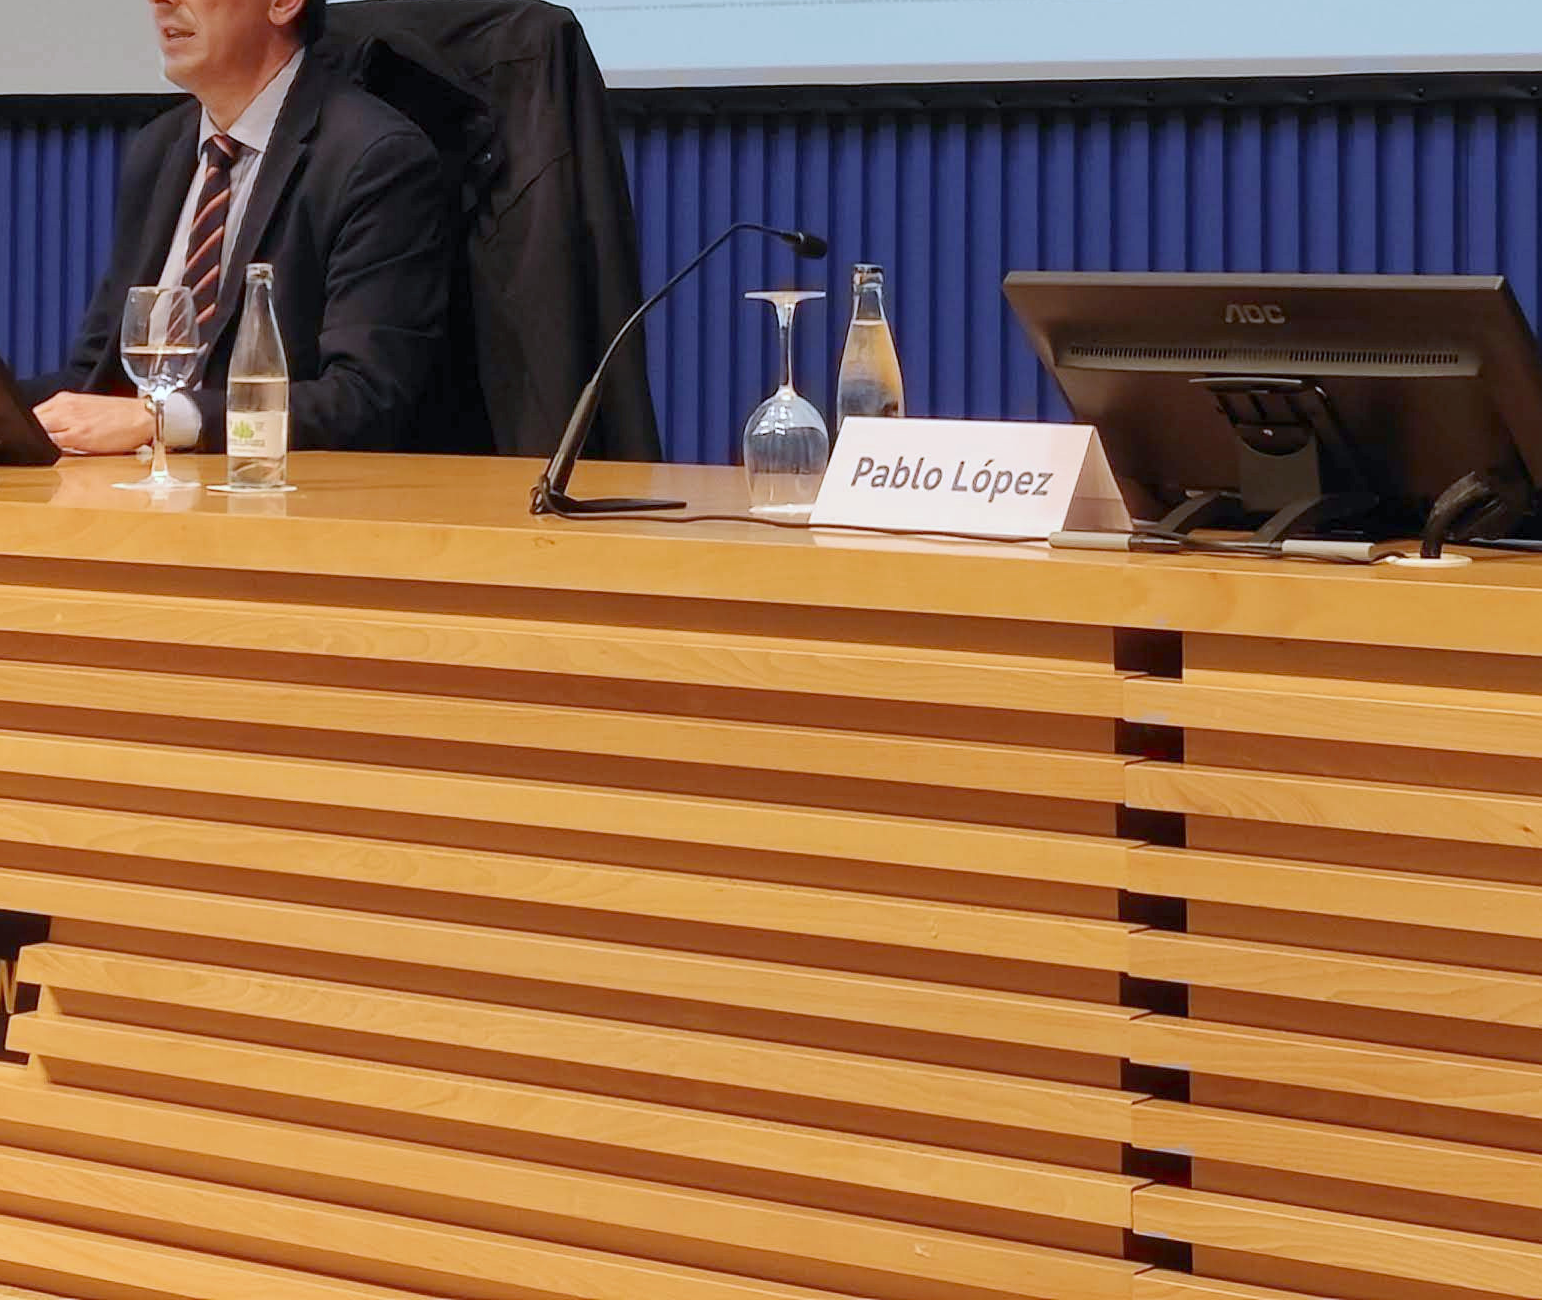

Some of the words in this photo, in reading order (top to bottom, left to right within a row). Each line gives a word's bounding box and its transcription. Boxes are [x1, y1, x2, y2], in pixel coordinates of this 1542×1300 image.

[1226, 304, 1286, 324] AOC
[851, 456, 942, 491] Pablo
[951, 459, 1054, 503] López
